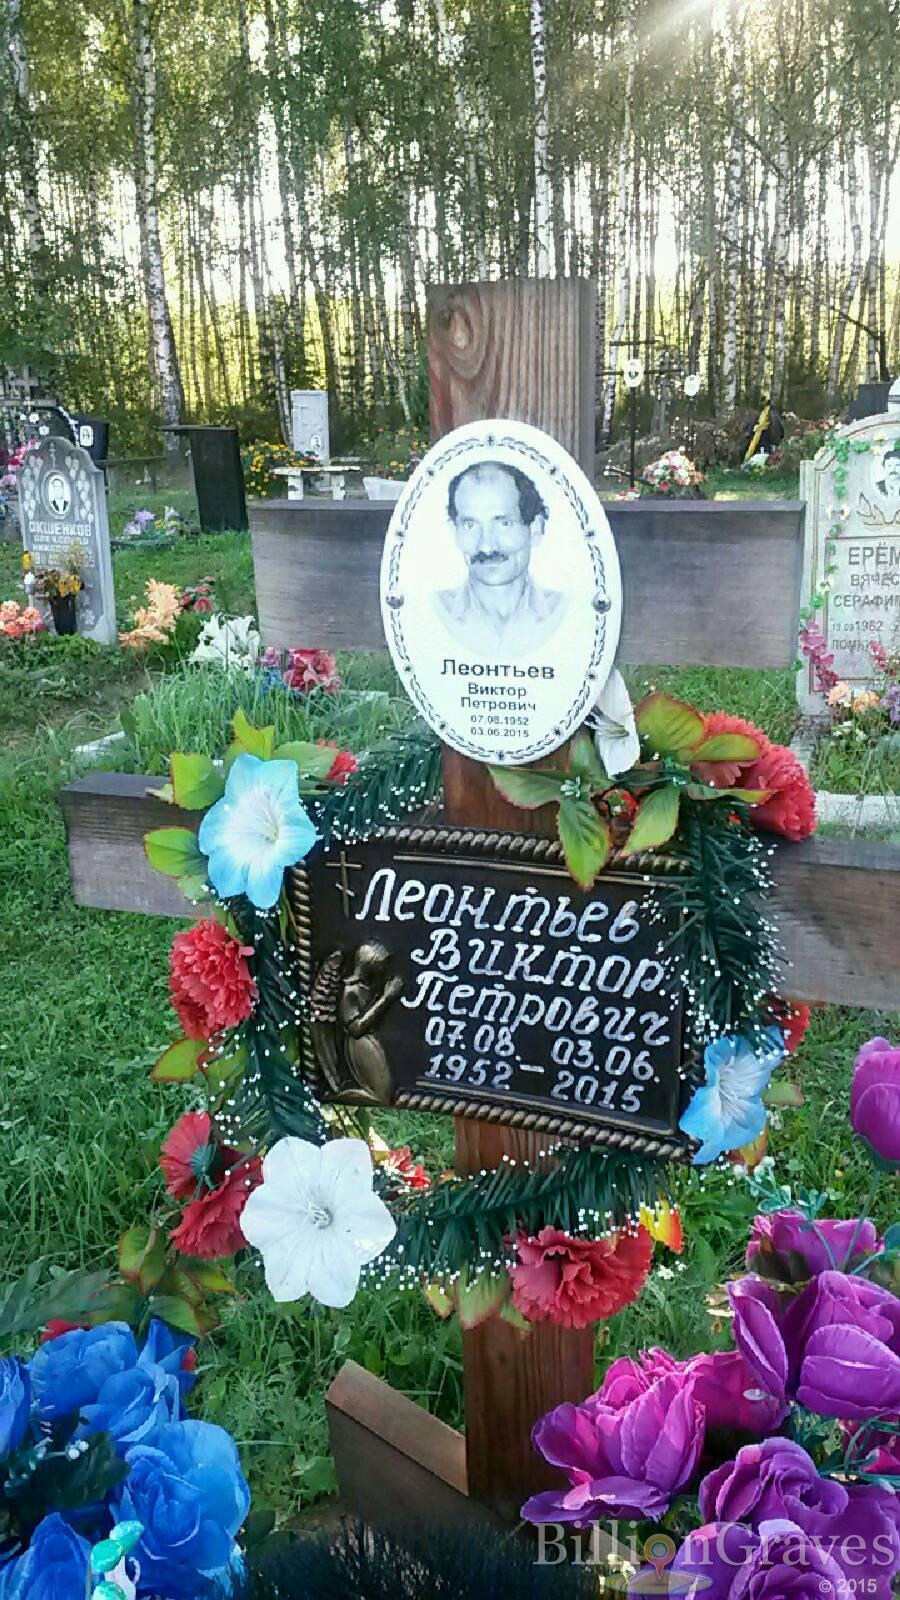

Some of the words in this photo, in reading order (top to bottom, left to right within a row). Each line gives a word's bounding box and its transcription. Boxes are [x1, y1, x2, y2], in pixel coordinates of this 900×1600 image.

[440, 659, 555, 680] Леонтьев
[468, 682, 527, 697] Виктор
[461, 697, 537, 711] Петрович
[355, 868, 641, 943] Леонтьев
[410, 928, 665, 999] Виктор
[400, 970, 672, 1046] Петрович
[551, 1070, 645, 1113] 2015
